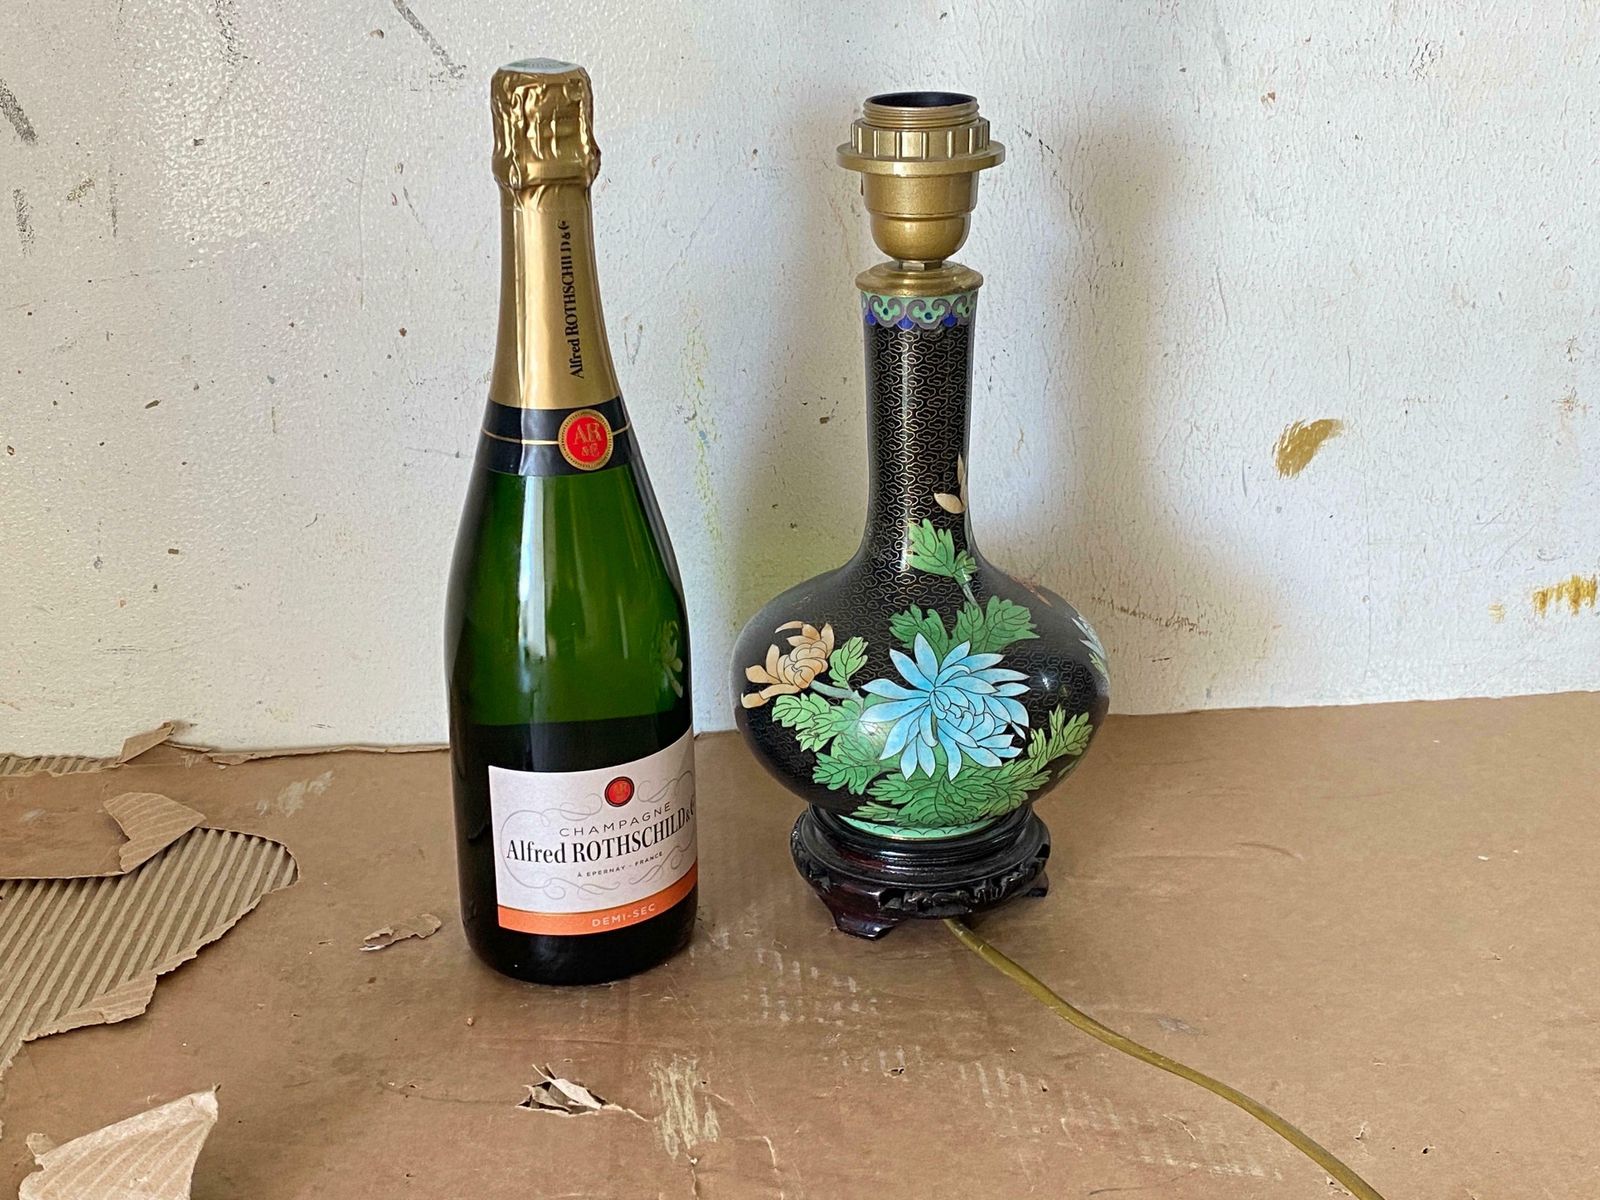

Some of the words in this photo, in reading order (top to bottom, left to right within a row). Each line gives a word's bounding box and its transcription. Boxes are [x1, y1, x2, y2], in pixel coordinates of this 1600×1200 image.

[560, 241, 579, 336] ROTHSCHILD
[568, 338, 584, 379] Alfred
[559, 801, 671, 837] CHAMPAGNE
[506, 839, 566, 864] Alfred
[586, 864, 626, 877] EPERNAY
[634, 851, 663, 866] FRANCE
[591, 903, 656, 928] DEMI-SEC
